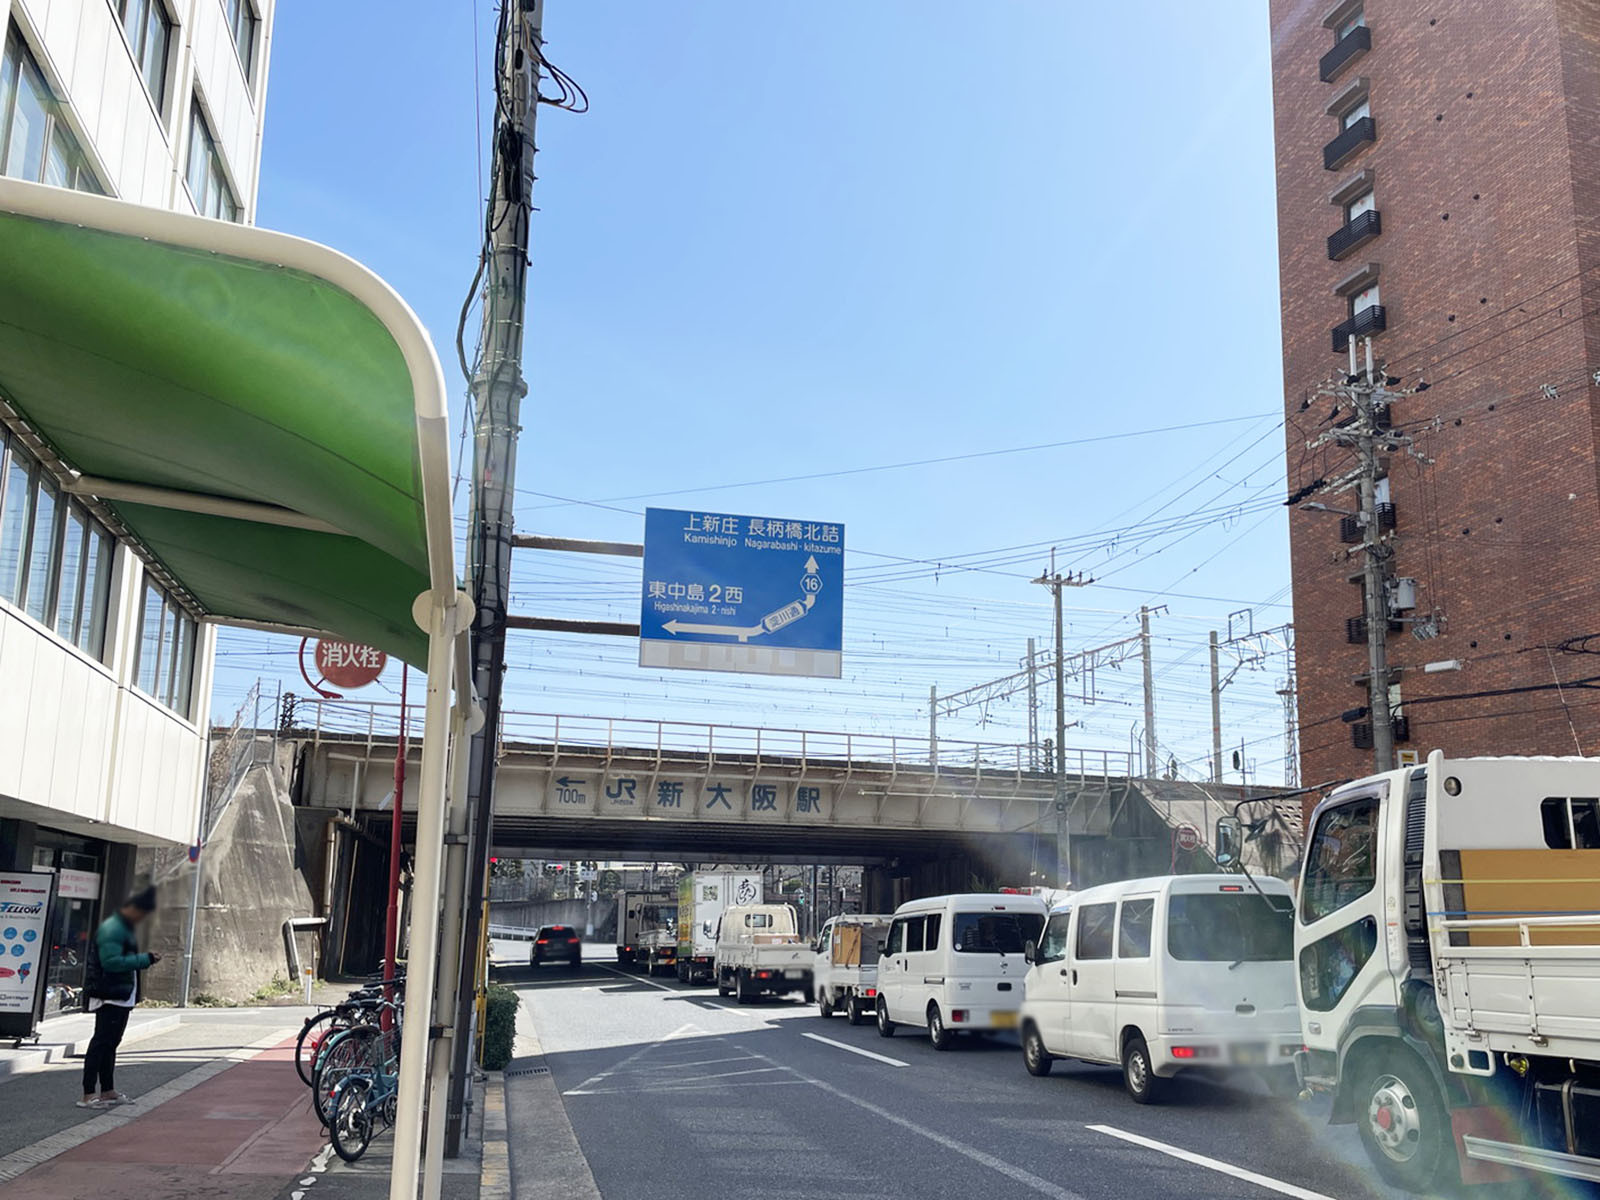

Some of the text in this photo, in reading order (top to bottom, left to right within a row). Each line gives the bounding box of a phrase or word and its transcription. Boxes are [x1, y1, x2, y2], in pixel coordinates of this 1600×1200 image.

[683, 513, 839, 543] 上新庄 長柄橋北詰
[684, 533, 737, 548] Kamishinjo
[805, 578, 818, 591] 16
[654, 601, 708, 615] Higashinakajima
[321, 642, 380, 668] 消火栓
[555, 788, 585, 804] 700m
[606, 778, 821, 813] JR 新大阪駅
